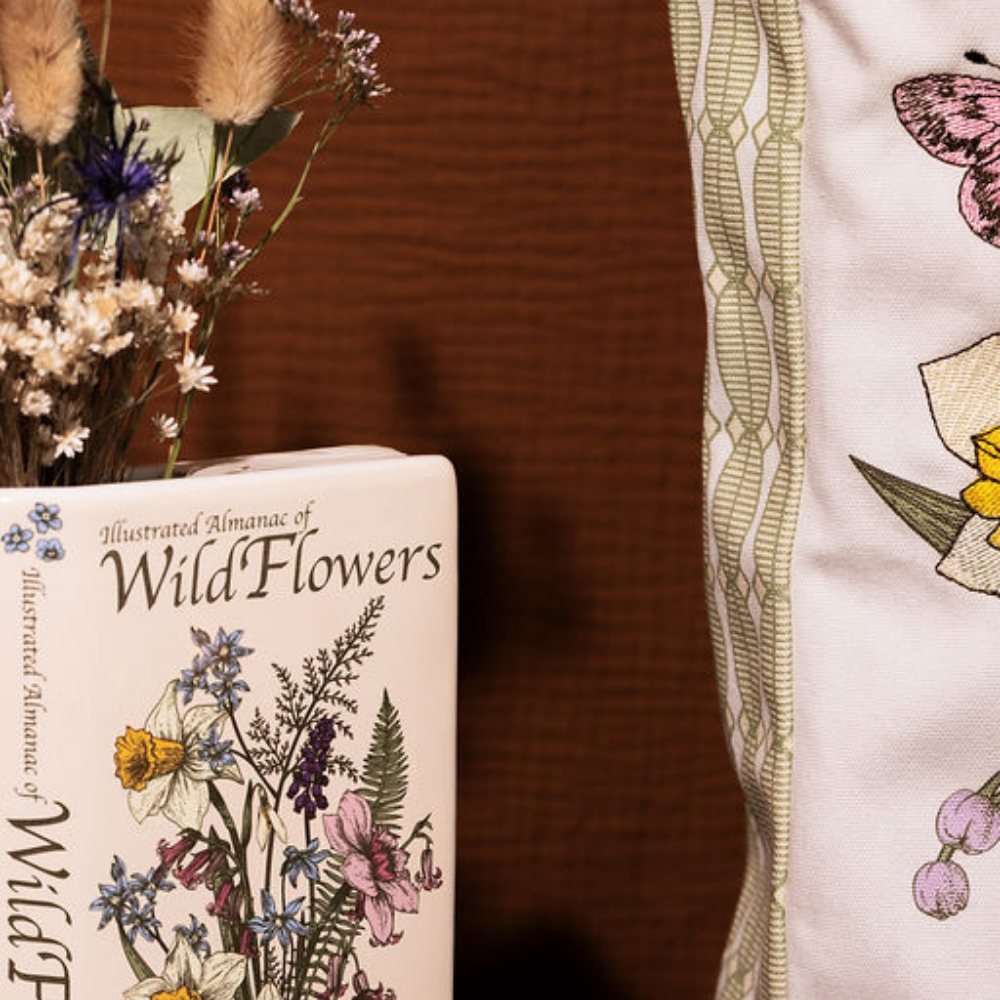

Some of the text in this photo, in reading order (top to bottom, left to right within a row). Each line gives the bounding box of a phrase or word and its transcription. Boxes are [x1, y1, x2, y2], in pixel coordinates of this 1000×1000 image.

[100, 500, 315, 545] Illustrated Almanac of
[14, 567, 48, 804] Illustrated Almanac of
